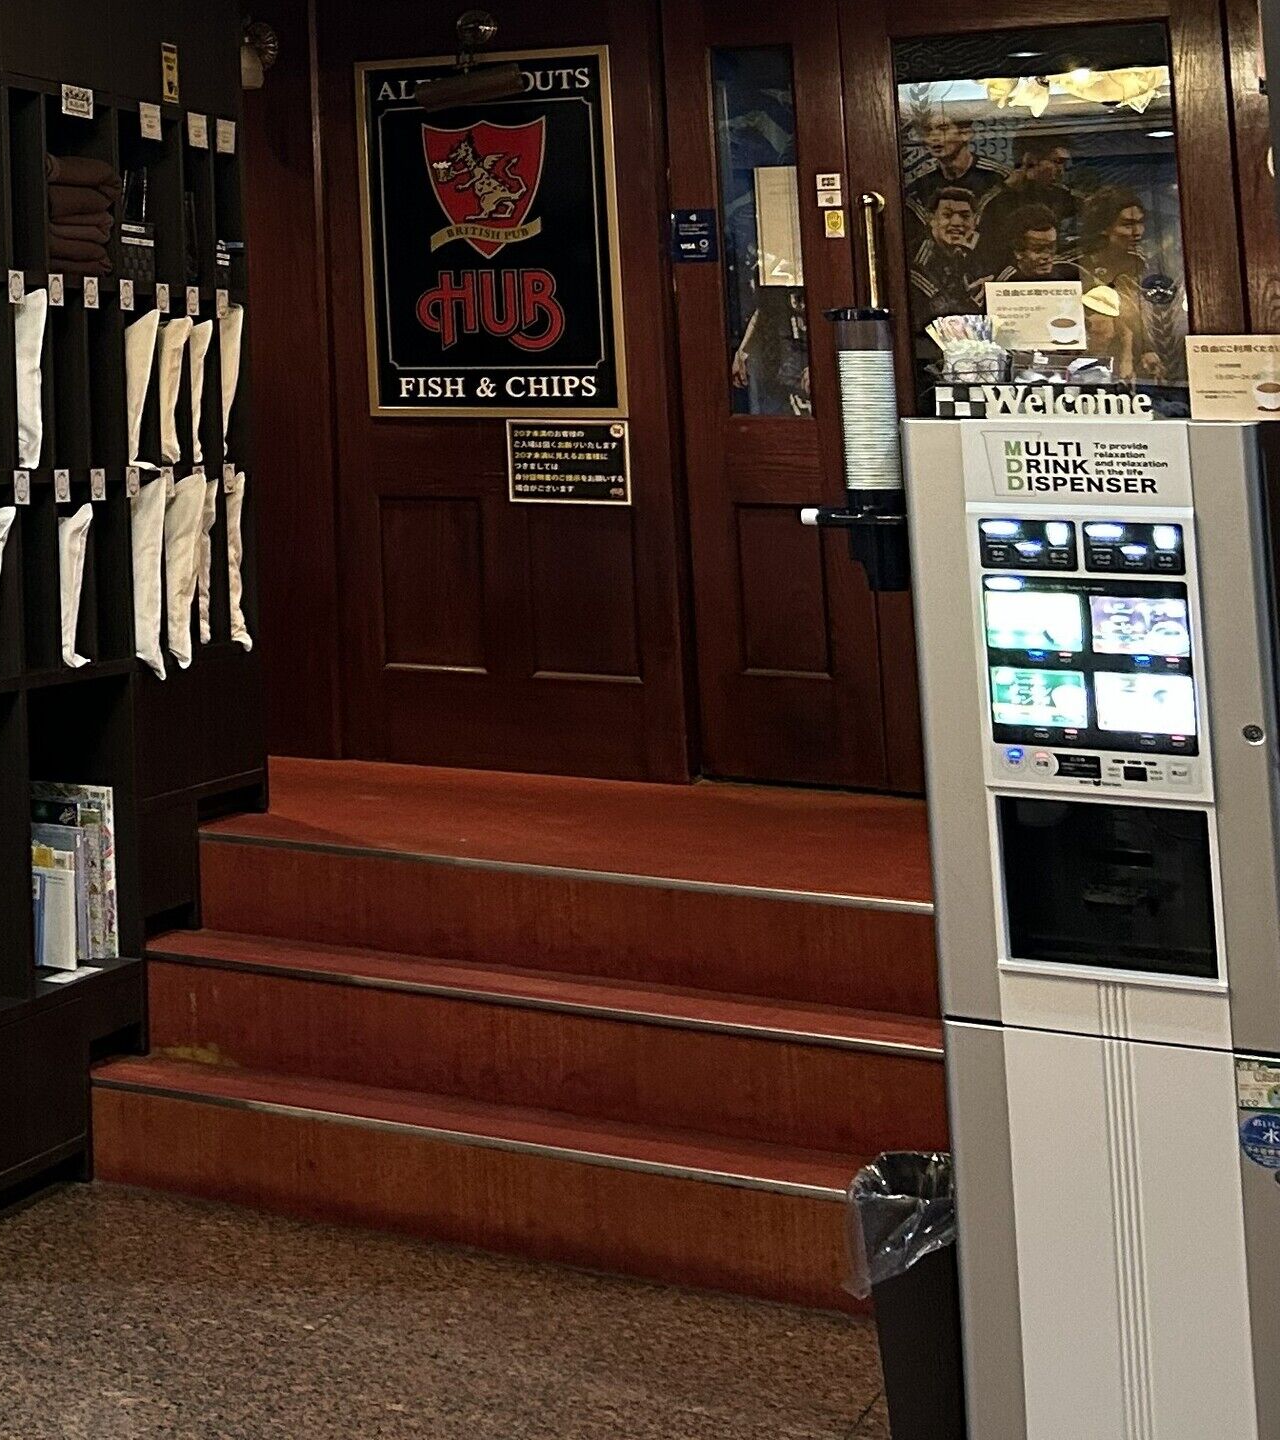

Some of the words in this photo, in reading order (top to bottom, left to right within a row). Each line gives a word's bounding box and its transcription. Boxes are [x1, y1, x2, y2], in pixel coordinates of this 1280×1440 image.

[377, 79, 431, 101] AL
[521, 67, 591, 92] OUTS
[446, 225, 501, 240] BRITISH
[503, 228, 530, 240] PUB
[416, 268, 566, 352] HUB
[399, 377, 466, 398] FISH
[475, 376, 497, 398] &
[505, 375, 597, 398] CHIPS
[984, 384, 1153, 416] Welcome
[1004, 440, 1082, 457] MULTI
[1093, 442, 1107, 450] To
[1109, 442, 1148, 451] provide
[1094, 451, 1146, 459] relaxation
[1007, 459, 1090, 475] DRINK
[1095, 459, 1114, 467] and
[1116, 460, 1168, 468] relaxation
[1095, 468, 1105, 476] in
[1107, 468, 1124, 476] the
[1126, 468, 1144, 476] life
[1007, 475, 1158, 494] DISPENSER
